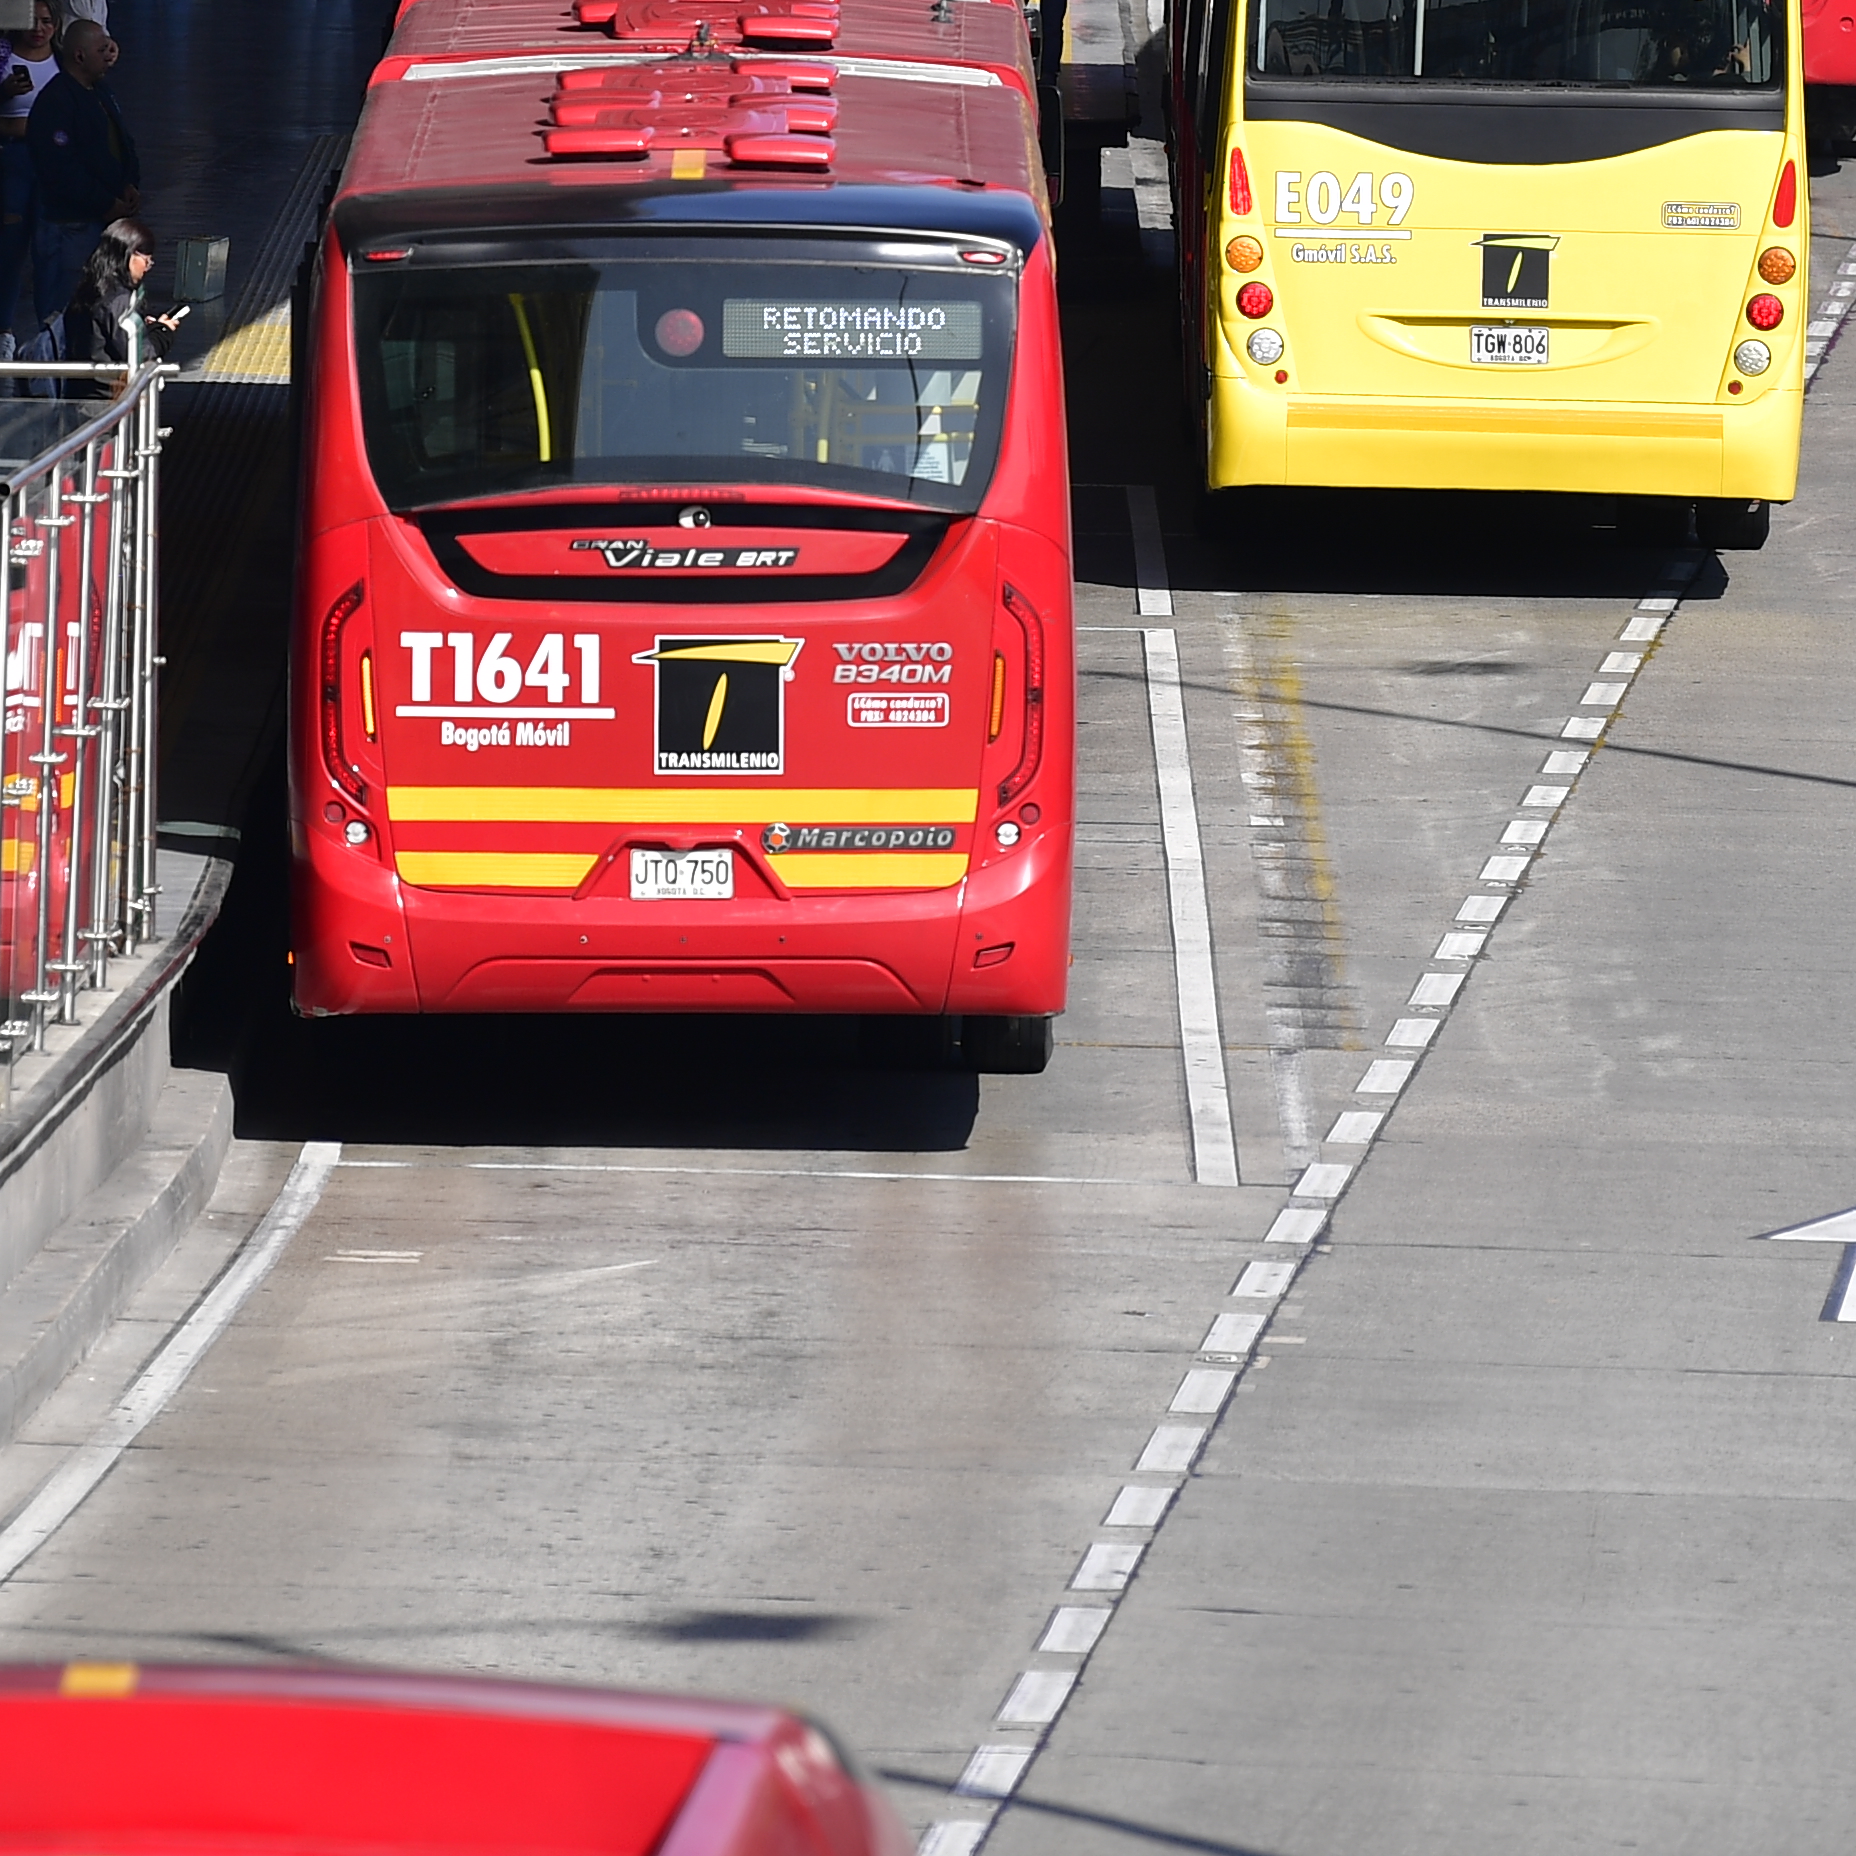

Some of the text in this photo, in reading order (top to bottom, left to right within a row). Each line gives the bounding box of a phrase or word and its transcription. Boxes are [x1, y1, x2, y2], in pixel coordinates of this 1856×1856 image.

[1274, 170, 1415, 226] E049
[1292, 243, 1397, 264] Gmóvil S.A.S.
[1482, 297, 1548, 308] TRANSMILENIO
[763, 307, 945, 329] RETOMANDO
[783, 332, 922, 355] SERVICIO
[1474, 333, 1546, 354] TGW 806
[604, 548, 796, 567] Viale BRT
[832, 642, 953, 662] VOLVO
[400, 631, 600, 704] T1641
[833, 664, 952, 684] B340M
[853, 696, 943, 709] ¿Cómo conduzco?
[441, 721, 571, 752] Bogotá Móvil
[658, 751, 780, 770] TRANSMILENIO
[686, 859, 729, 886] 750
